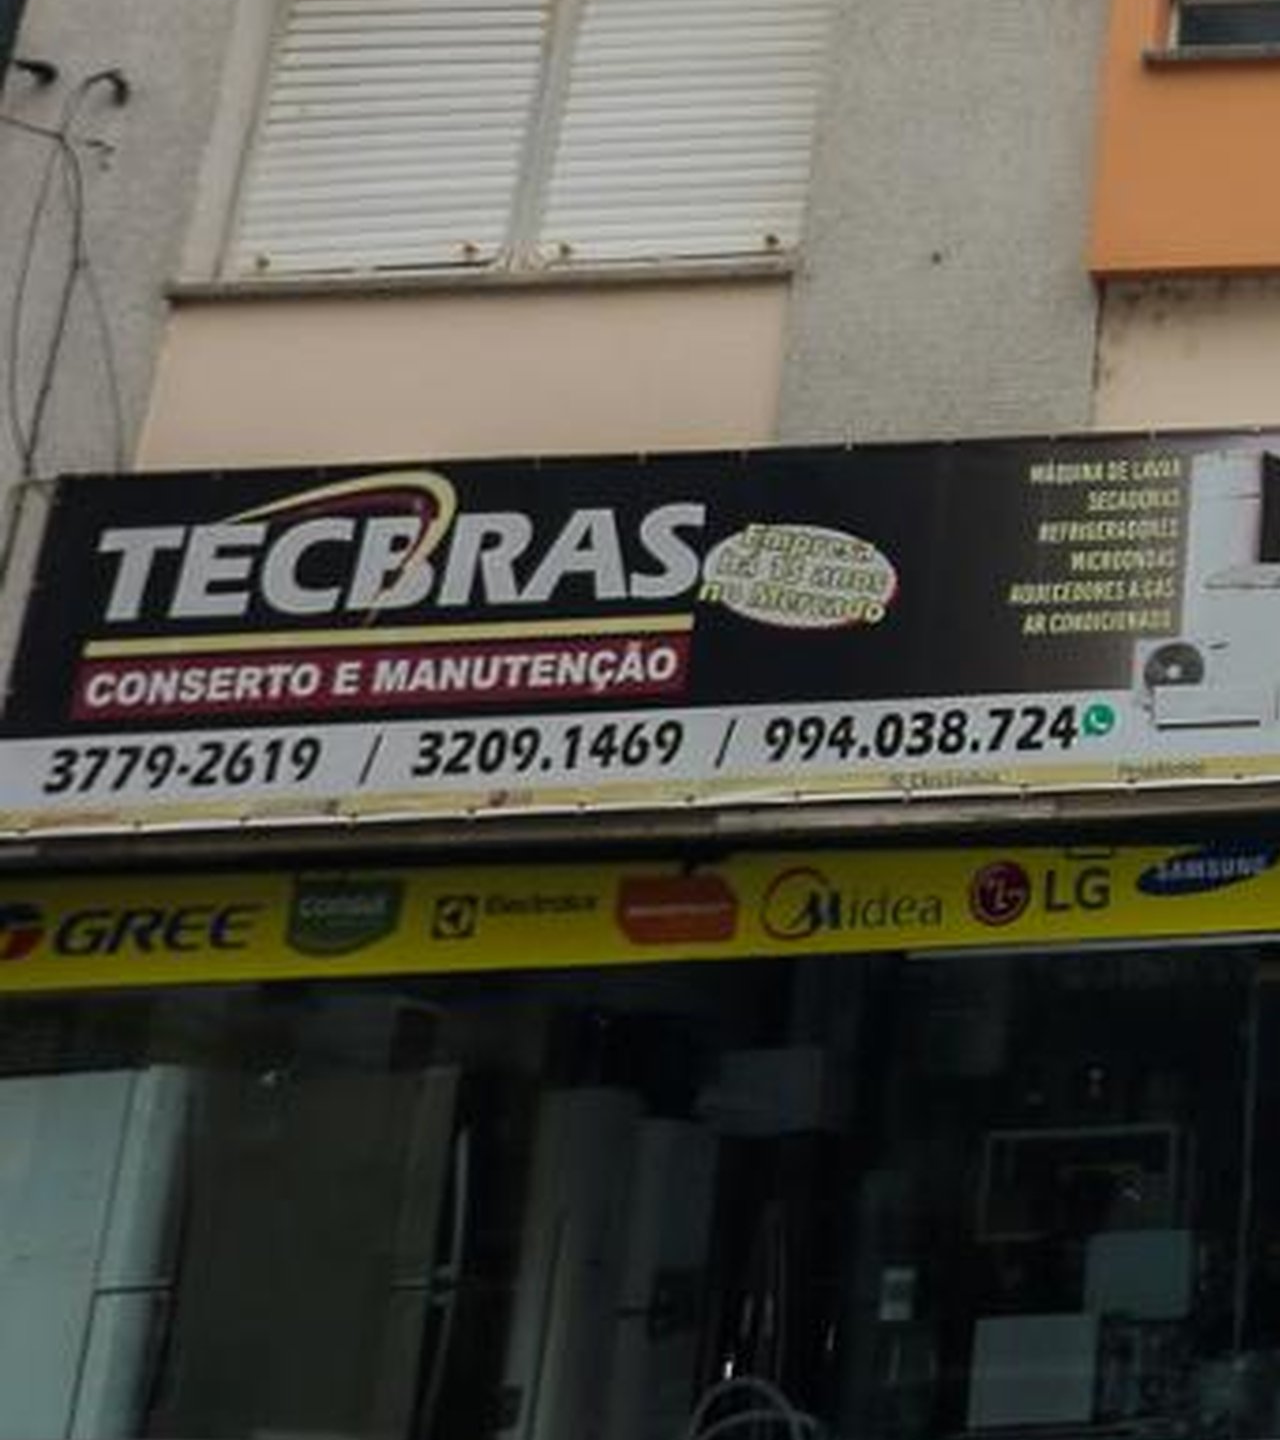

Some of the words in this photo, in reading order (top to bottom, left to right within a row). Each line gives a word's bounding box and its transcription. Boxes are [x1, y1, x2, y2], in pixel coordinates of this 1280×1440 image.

[102, 503, 706, 620] TECBRAS
[86, 662, 318, 708] CONSERTO
[331, 660, 361, 696] E
[373, 642, 680, 693] MANUTENÇÃO
[43, 737, 322, 796] 3779-2619
[409, 720, 685, 779] 3209.1469
[764, 705, 1080, 763] 994.038.724
[1045, 868, 1113, 913] LG
[54, 903, 264, 954] GREE
